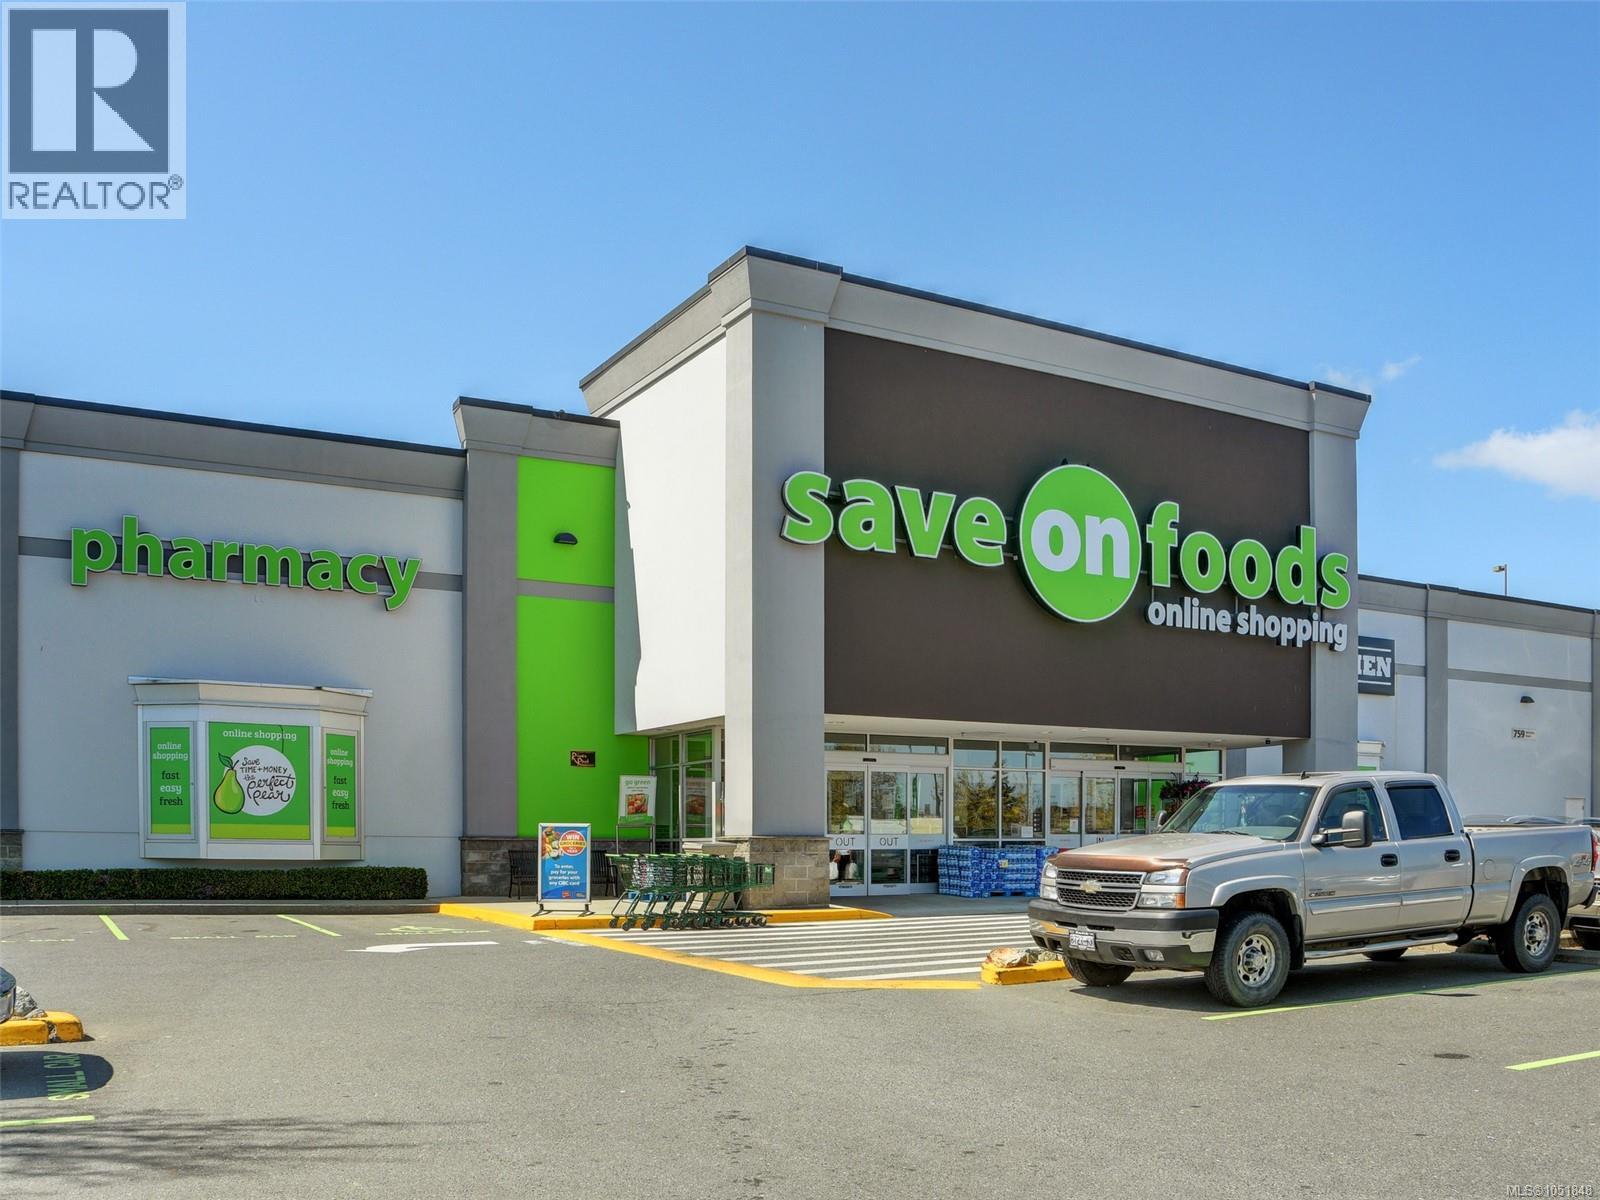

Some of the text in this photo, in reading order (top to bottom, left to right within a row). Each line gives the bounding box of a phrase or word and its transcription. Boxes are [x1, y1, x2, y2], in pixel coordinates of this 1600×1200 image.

[780, 471, 1351, 610] save on foods
[71, 514, 422, 611] pharmacy
[1147, 597, 1348, 651] online shopping
[222, 729, 297, 741] online shopping
[1513, 729, 1525, 738] 759
[157, 741, 182, 750] online
[152, 751, 188, 761] shopping
[330, 748, 349, 756] online
[242, 757, 260, 766] Save
[327, 757, 353, 768] shopping
[161, 770, 181, 780] fast
[333, 776, 347, 784] fast
[160, 784, 182, 794] easy
[247, 774, 296, 799] perfect
[253, 789, 291, 806] pear
[332, 789, 349, 799] easy
[160, 797, 183, 806] fresh
[332, 801, 350, 809] fresh
[835, 837, 856, 847] OUT
[879, 837, 900, 847] OUT
[46, 1070, 90, 1101] SMALL
